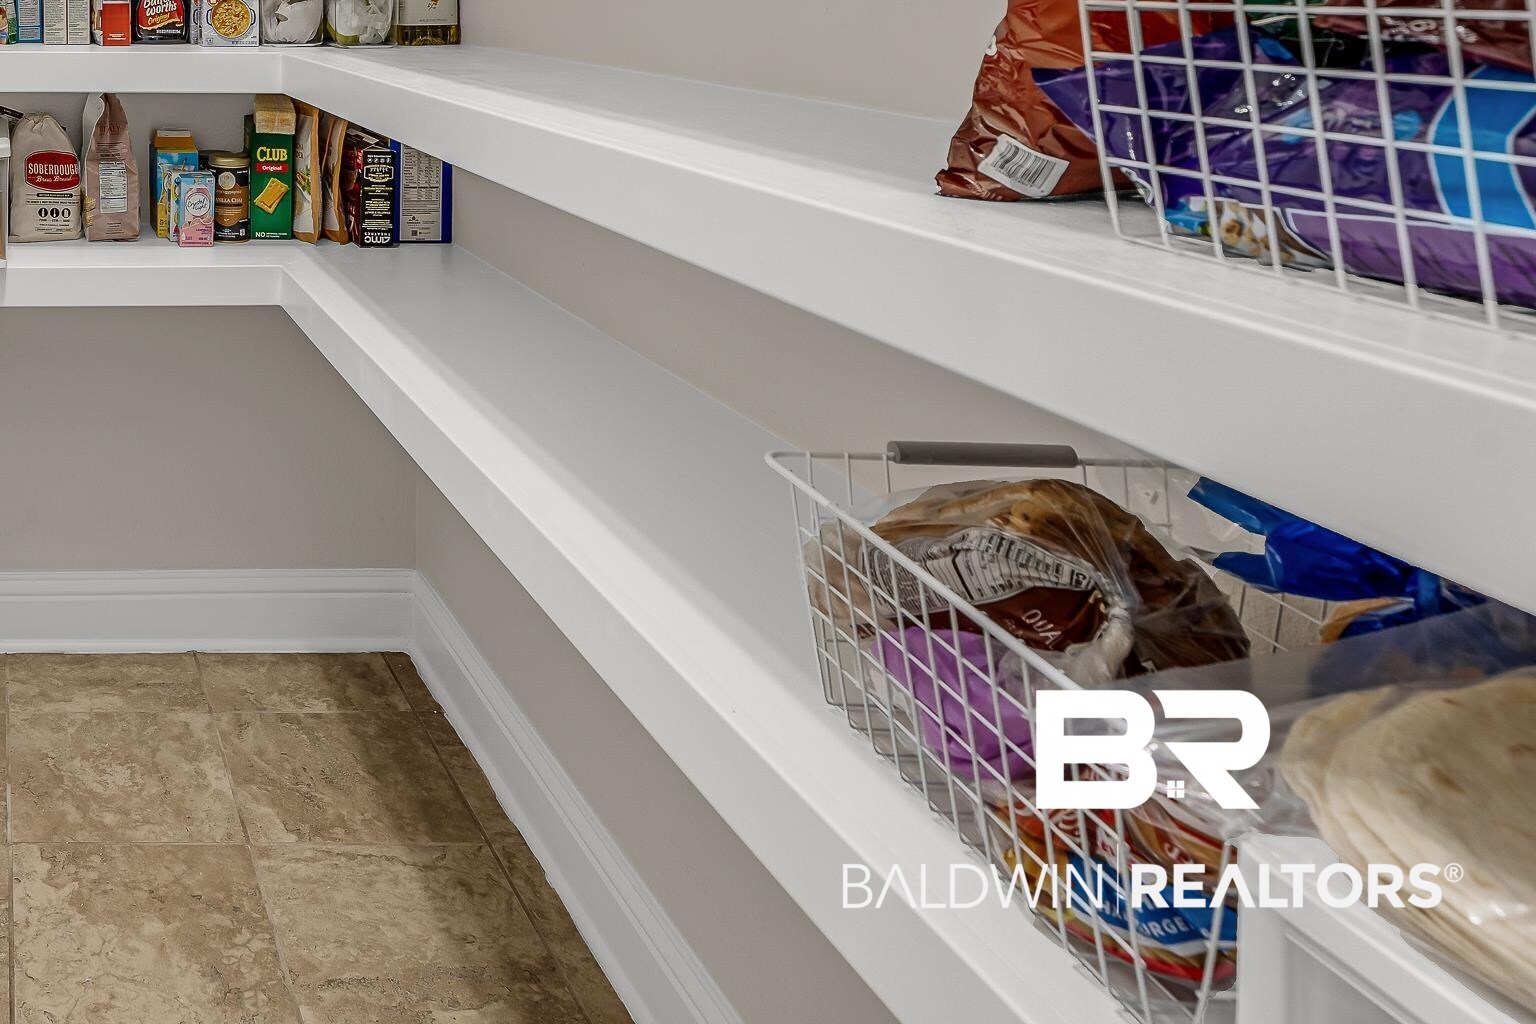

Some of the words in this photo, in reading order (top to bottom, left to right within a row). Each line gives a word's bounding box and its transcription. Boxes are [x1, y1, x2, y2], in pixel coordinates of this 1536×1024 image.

[146, 1, 177, 17] worth's
[147, 13, 170, 25] Original
[256, 147, 288, 162] CLUB
